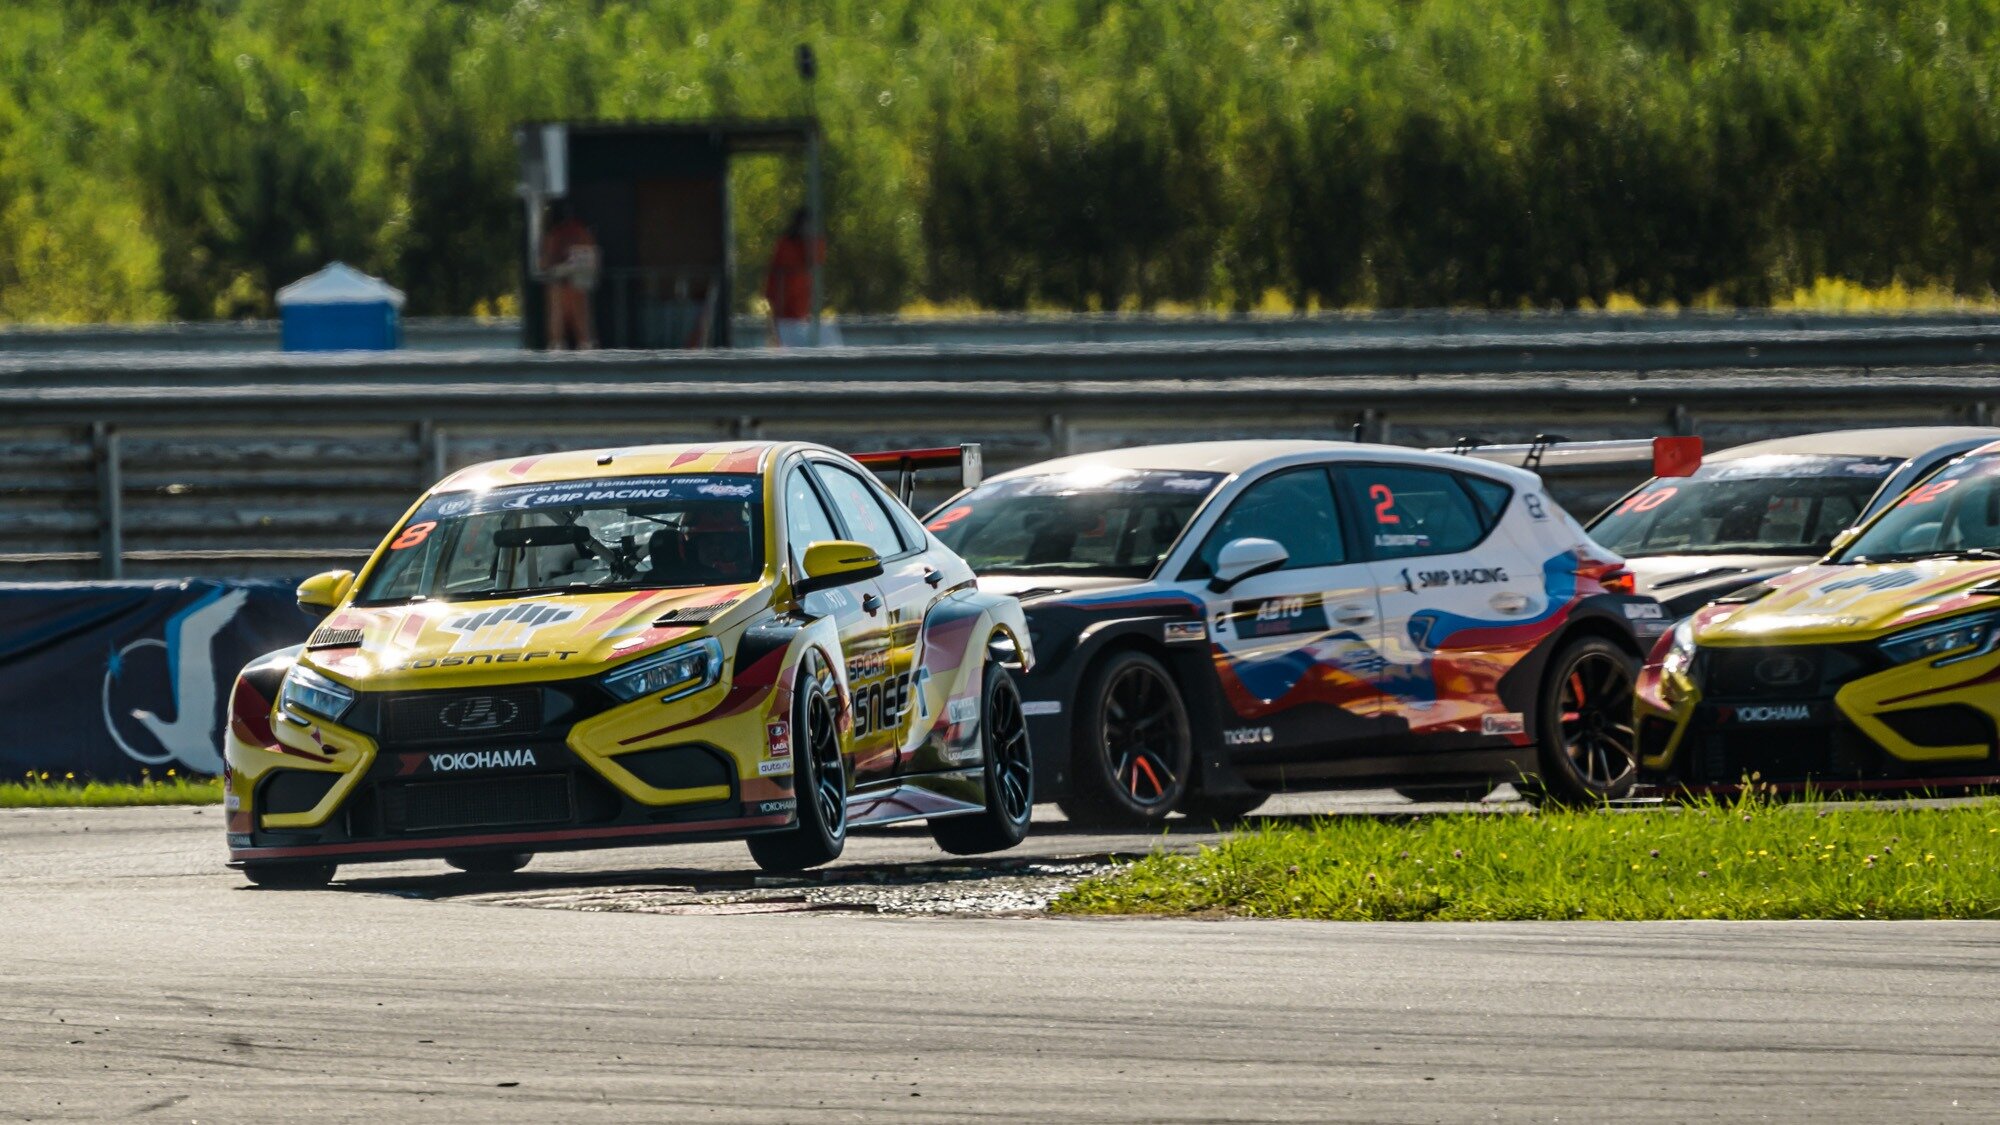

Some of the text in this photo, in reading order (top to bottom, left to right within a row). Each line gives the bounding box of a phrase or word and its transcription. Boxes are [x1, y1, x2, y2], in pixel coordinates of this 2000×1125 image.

[533, 488, 670, 505] SMP RACING
[1368, 483, 1400, 524] 2
[1614, 486, 1679, 517] 10
[390, 520, 438, 551] 8
[1417, 566, 1509, 588] SMP RACING
[388, 651, 578, 672] OSNEFT
[848, 652, 886, 682] SPORT
[1735, 704, 1810, 722] YOKOHAMA
[429, 748, 537, 772] YOKOHAMA
